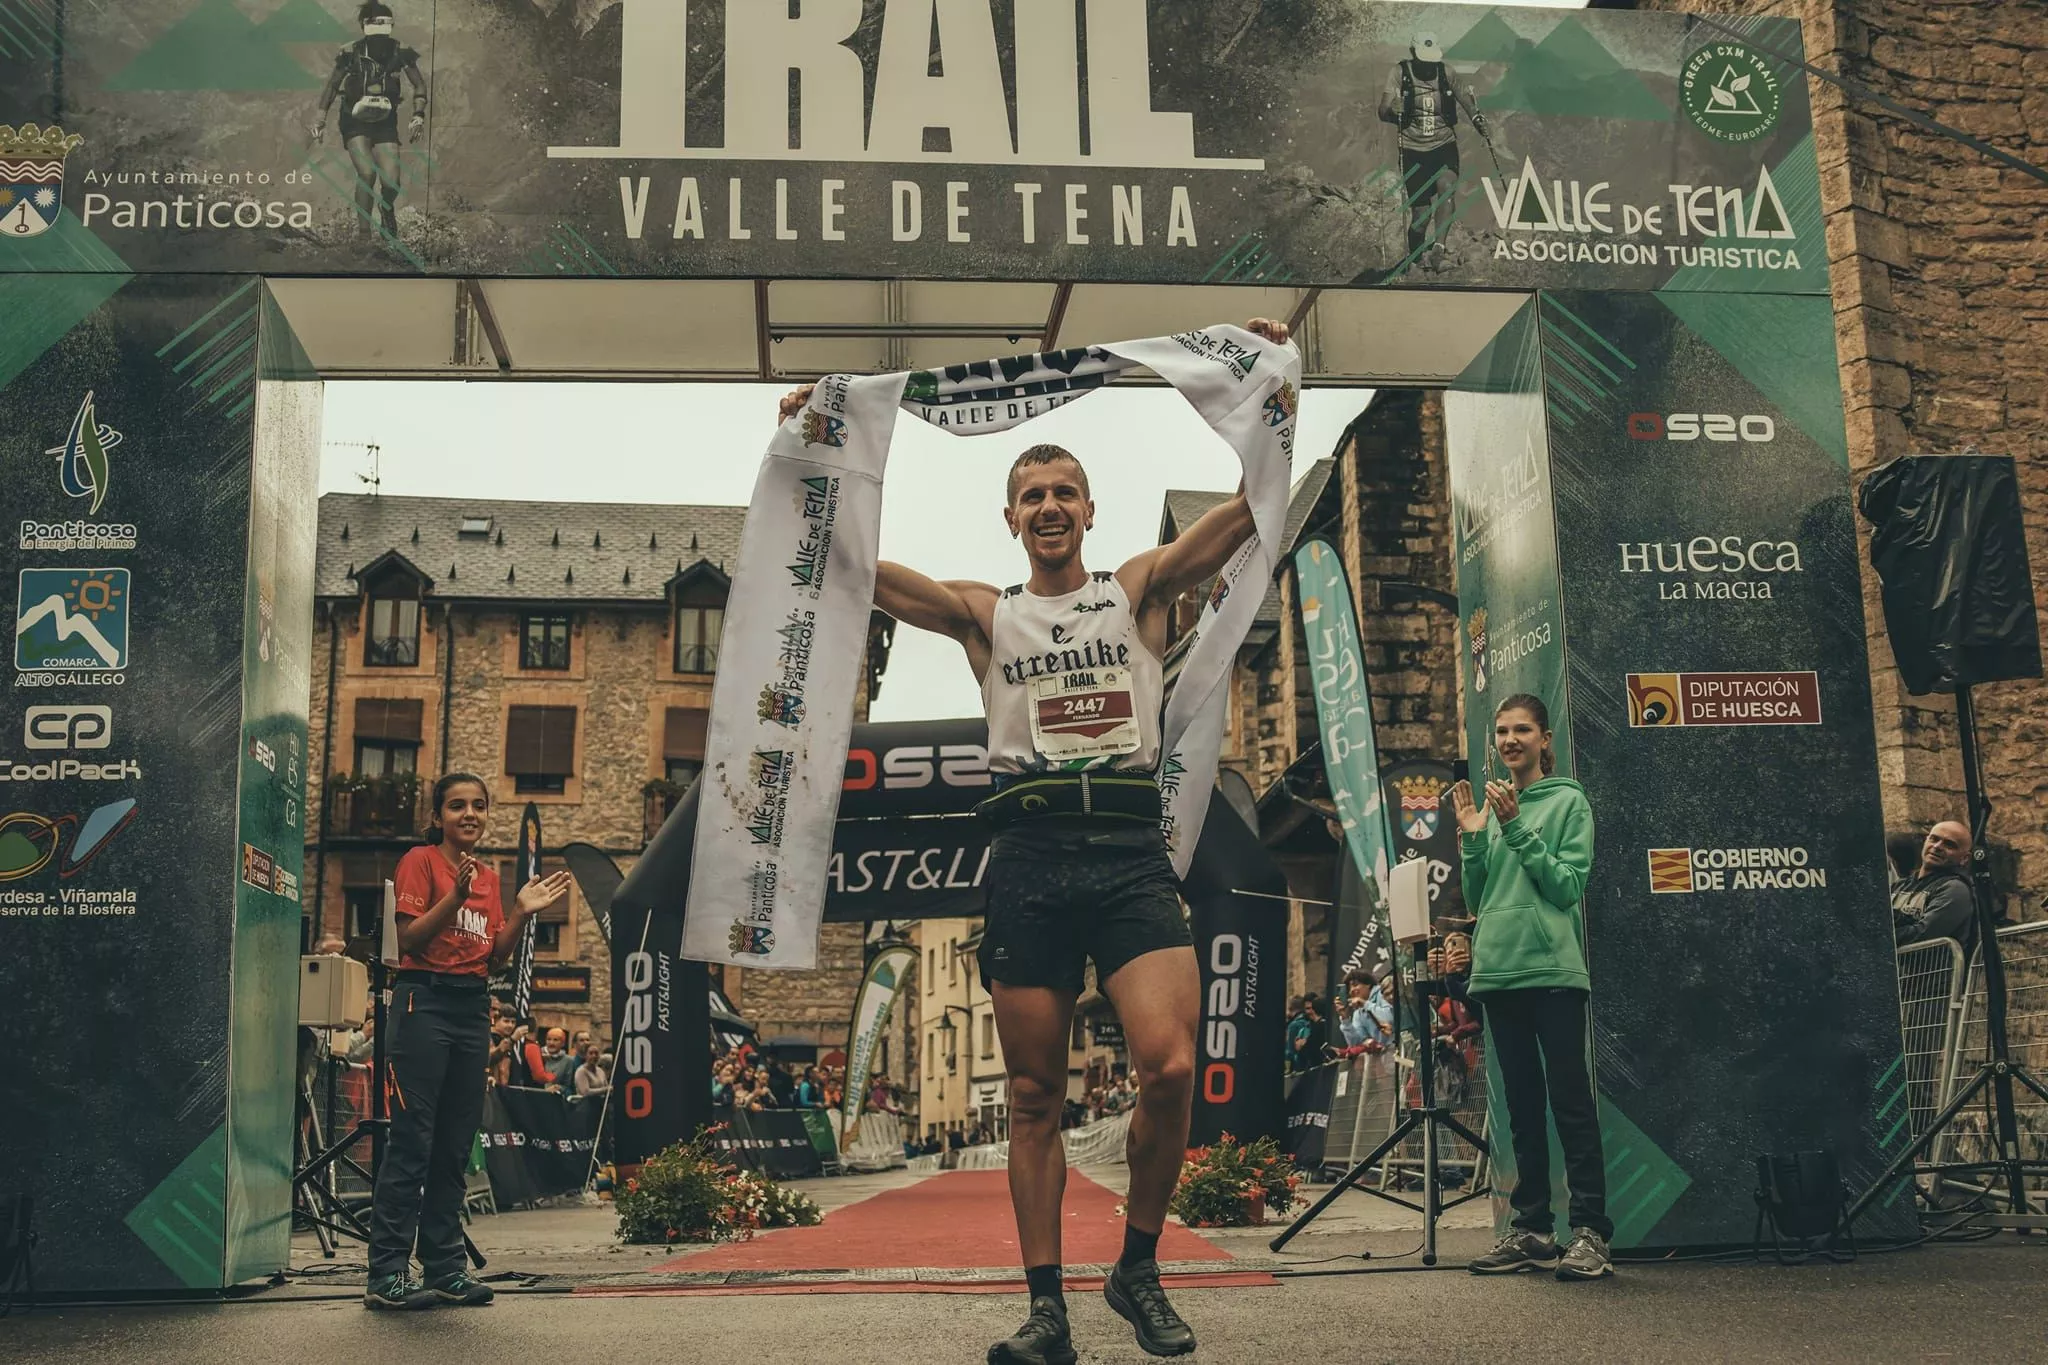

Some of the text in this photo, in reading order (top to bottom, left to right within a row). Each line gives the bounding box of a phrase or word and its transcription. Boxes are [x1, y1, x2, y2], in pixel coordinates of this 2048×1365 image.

[1684, 46, 1777, 91] GREEN CXM TRAIL
[84, 168, 312, 187] Ayuntamiento de
[1481, 154, 1796, 239] VALLE DE TENA
[82, 193, 312, 229] Panticosa
[619, 177, 1198, 247] VALLE DE TENA
[1494, 240, 1801, 270] ASOCIACION TURISTICA
[1200, 335, 1217, 350] DE
[922, 406, 994, 425] VALLE
[1008, 400, 1034, 419] DE
[20, 520, 136, 538] Panticosa
[786, 476, 828, 588] VALLE DE TENA
[815, 477, 840, 591] ASOCIACION TURISTICA
[20, 539, 33, 549] La
[78, 538, 95, 549] del
[98, 538, 136, 549] Pirineo
[1618, 536, 1803, 572] Huesca
[1539, 599, 1549, 613] de
[42, 658, 98, 667] COMARCA
[1003, 638, 1129, 685] etrenike
[1490, 622, 1551, 676] Panticosa
[1061, 672, 1098, 689] TRAIL
[1690, 678, 1799, 697] DIPUTACIÓN
[1063, 697, 1106, 715] 2447
[1692, 701, 1801, 718] DE HUESCA
[773, 751, 794, 848] ASOCIACION TURISTICA
[745, 805, 774, 844] VALLE
[1693, 847, 1808, 869] GOBIERNO
[758, 863, 777, 922] Panticosa
[1695, 868, 1827, 891] DE ARAGON
[59, 888, 136, 903] Viñamala
[0, 904, 136, 916] serva de la Biosfera
[1244, 934, 1260, 1019] FAST&LIGHT
[658, 952, 671, 1032] FAST&LIGHT
